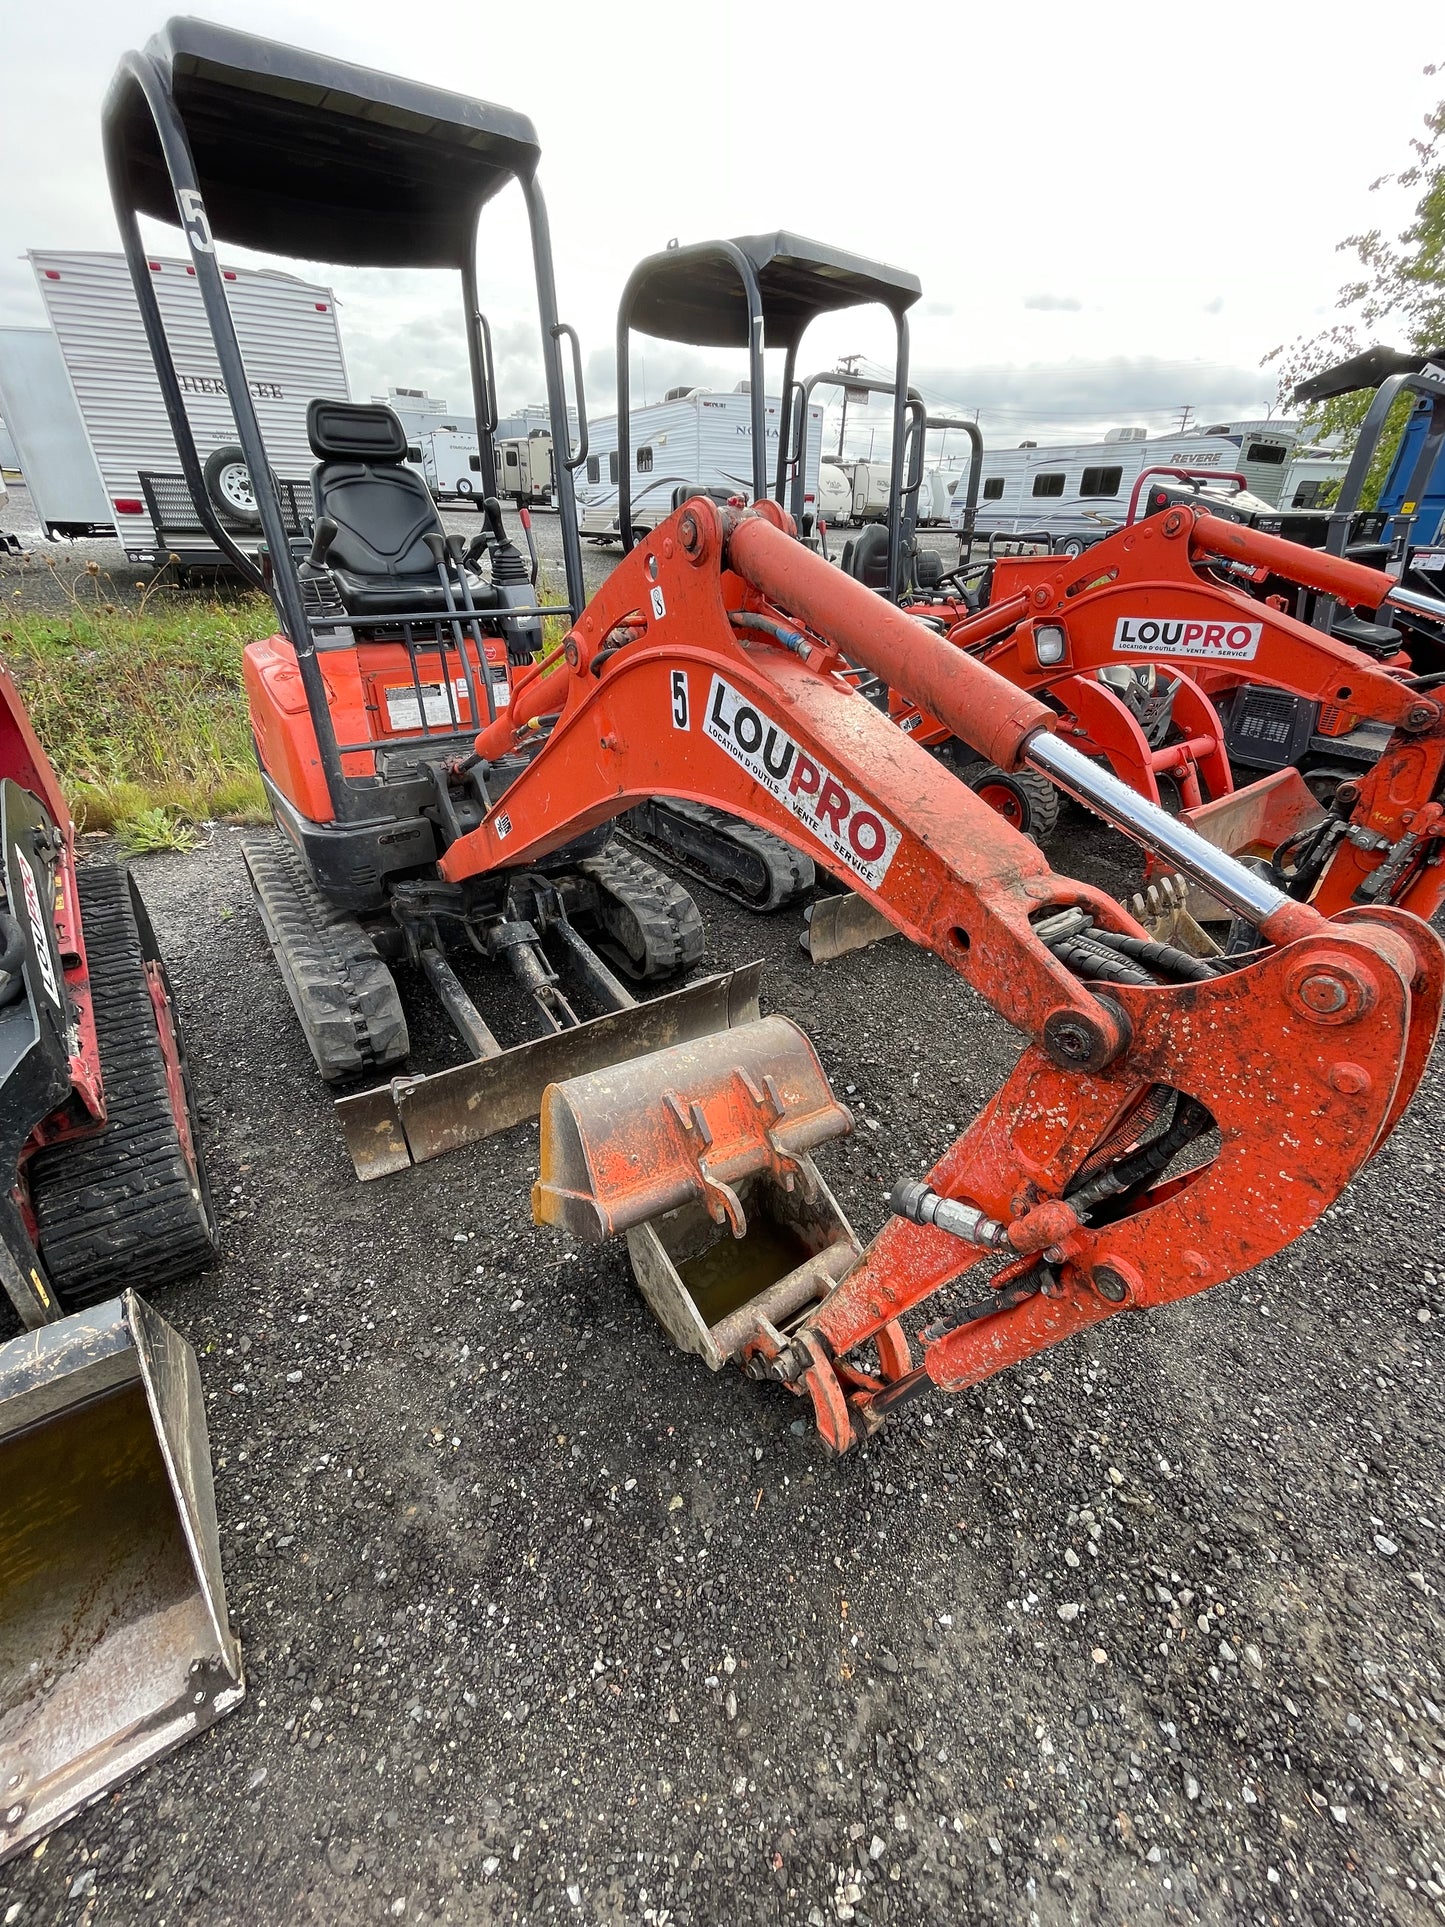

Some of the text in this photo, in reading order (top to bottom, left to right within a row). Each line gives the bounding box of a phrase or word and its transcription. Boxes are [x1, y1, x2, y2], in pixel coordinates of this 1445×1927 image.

[179, 189, 215, 253] 5
[1170, 453, 1222, 463] REVERE
[1121, 621, 1252, 650] LOUPRO
[673, 672, 687, 728] 5
[709, 725, 875, 881] LOCATION D'OUTILS VENTE SERVICE
[712, 682, 886, 862] LOUPRO
[19, 856, 55, 993] LOUPRO
